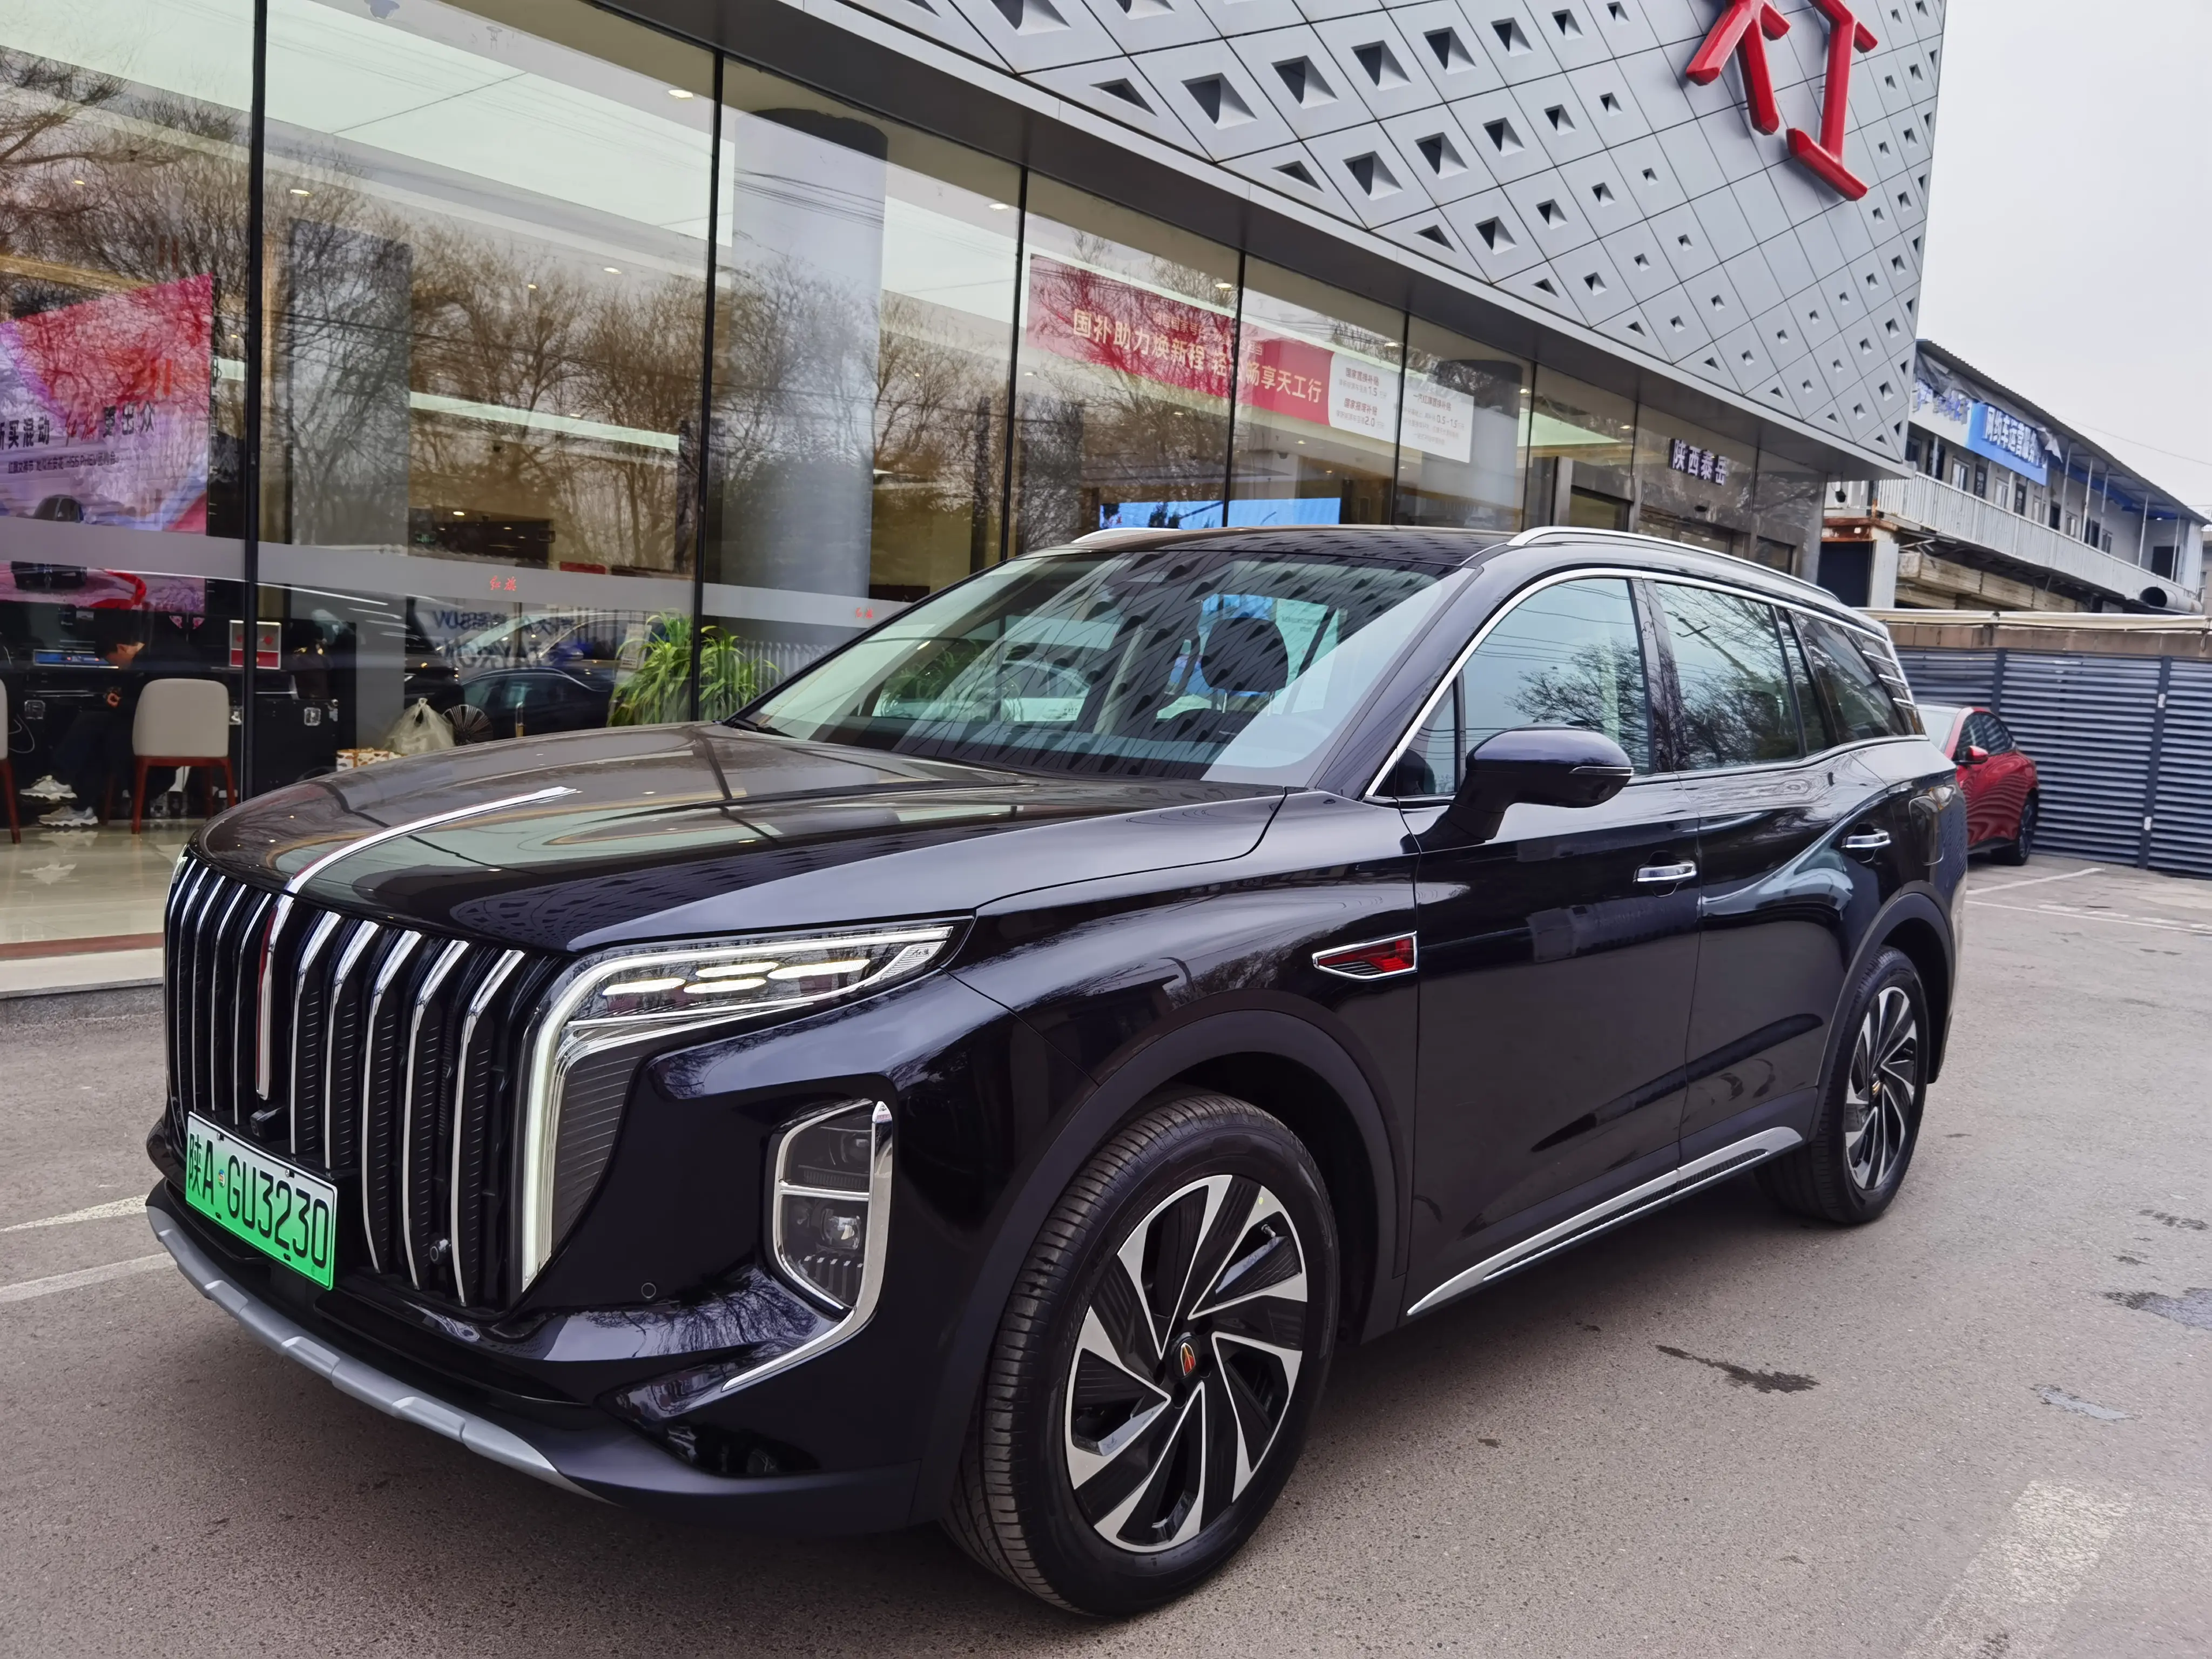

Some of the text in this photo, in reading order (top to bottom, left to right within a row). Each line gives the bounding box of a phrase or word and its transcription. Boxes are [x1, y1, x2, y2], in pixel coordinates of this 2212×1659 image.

[1074, 308, 1205, 370] 国补助力焕新程
[1672, 439, 1730, 486] 陕西泰岳
